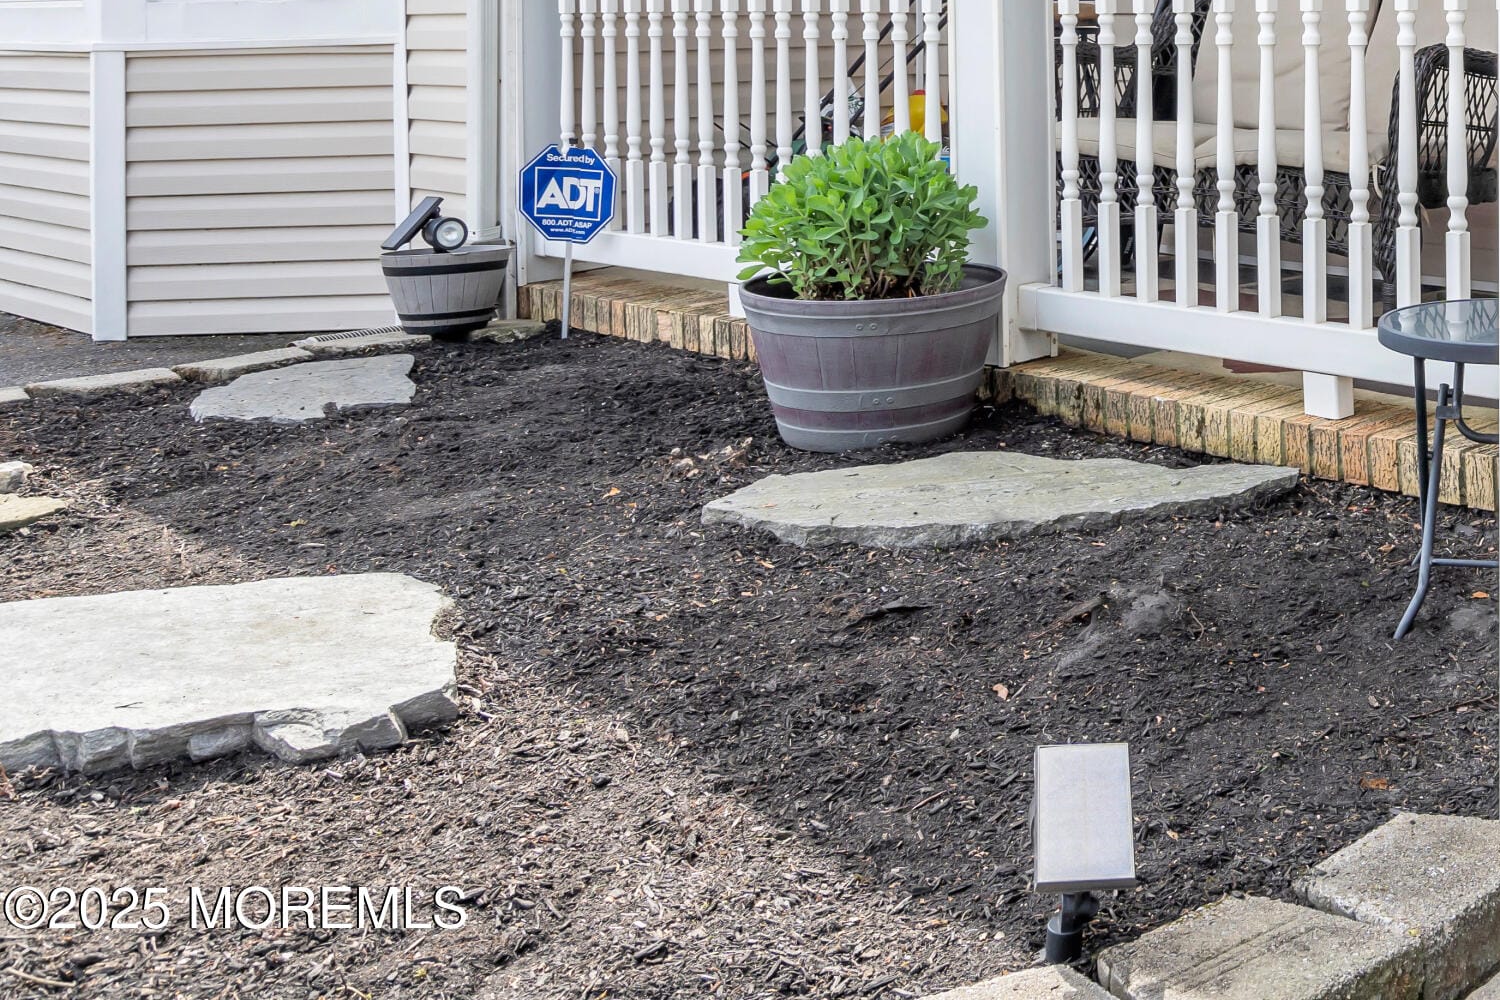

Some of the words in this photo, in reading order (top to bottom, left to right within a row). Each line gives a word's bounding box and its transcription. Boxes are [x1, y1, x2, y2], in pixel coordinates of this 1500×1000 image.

[546, 153, 584, 163] Secured
[585, 155, 596, 166] by
[536, 176, 602, 212] ADT
